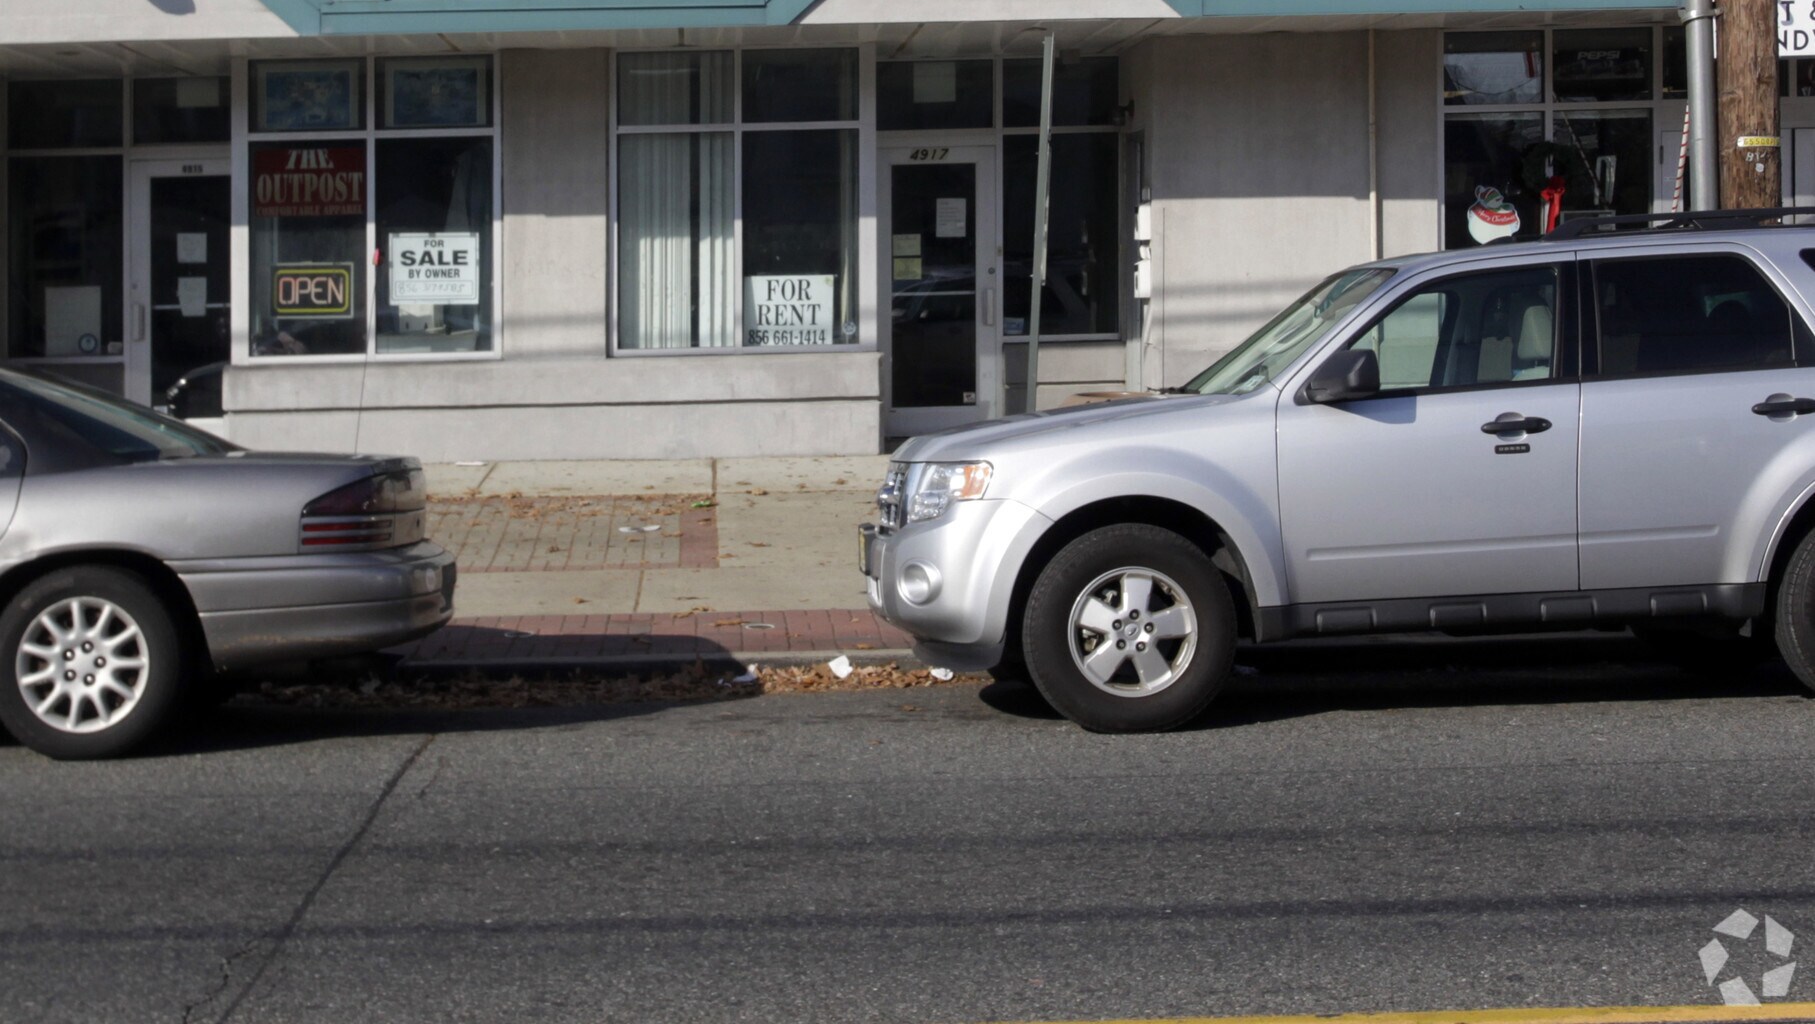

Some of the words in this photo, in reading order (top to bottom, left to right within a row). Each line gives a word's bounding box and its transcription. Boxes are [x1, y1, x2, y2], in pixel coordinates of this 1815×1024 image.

[1778, 29, 1815, 50] ND
[1577, 50, 1620, 60] PEPSI
[285, 148, 334, 169] THE
[910, 148, 949, 161] 4917
[257, 172, 363, 203] OUTPOST
[424, 239, 444, 248] FOR
[400, 250, 468, 266] SALE
[408, 269, 421, 279] BY
[425, 268, 460, 278] OWNER
[278, 277, 344, 305] OPEN
[767, 279, 812, 301] FOR
[757, 303, 821, 326] RENT
[748, 329, 769, 345] 856
[773, 329, 826, 345] 661-1414
